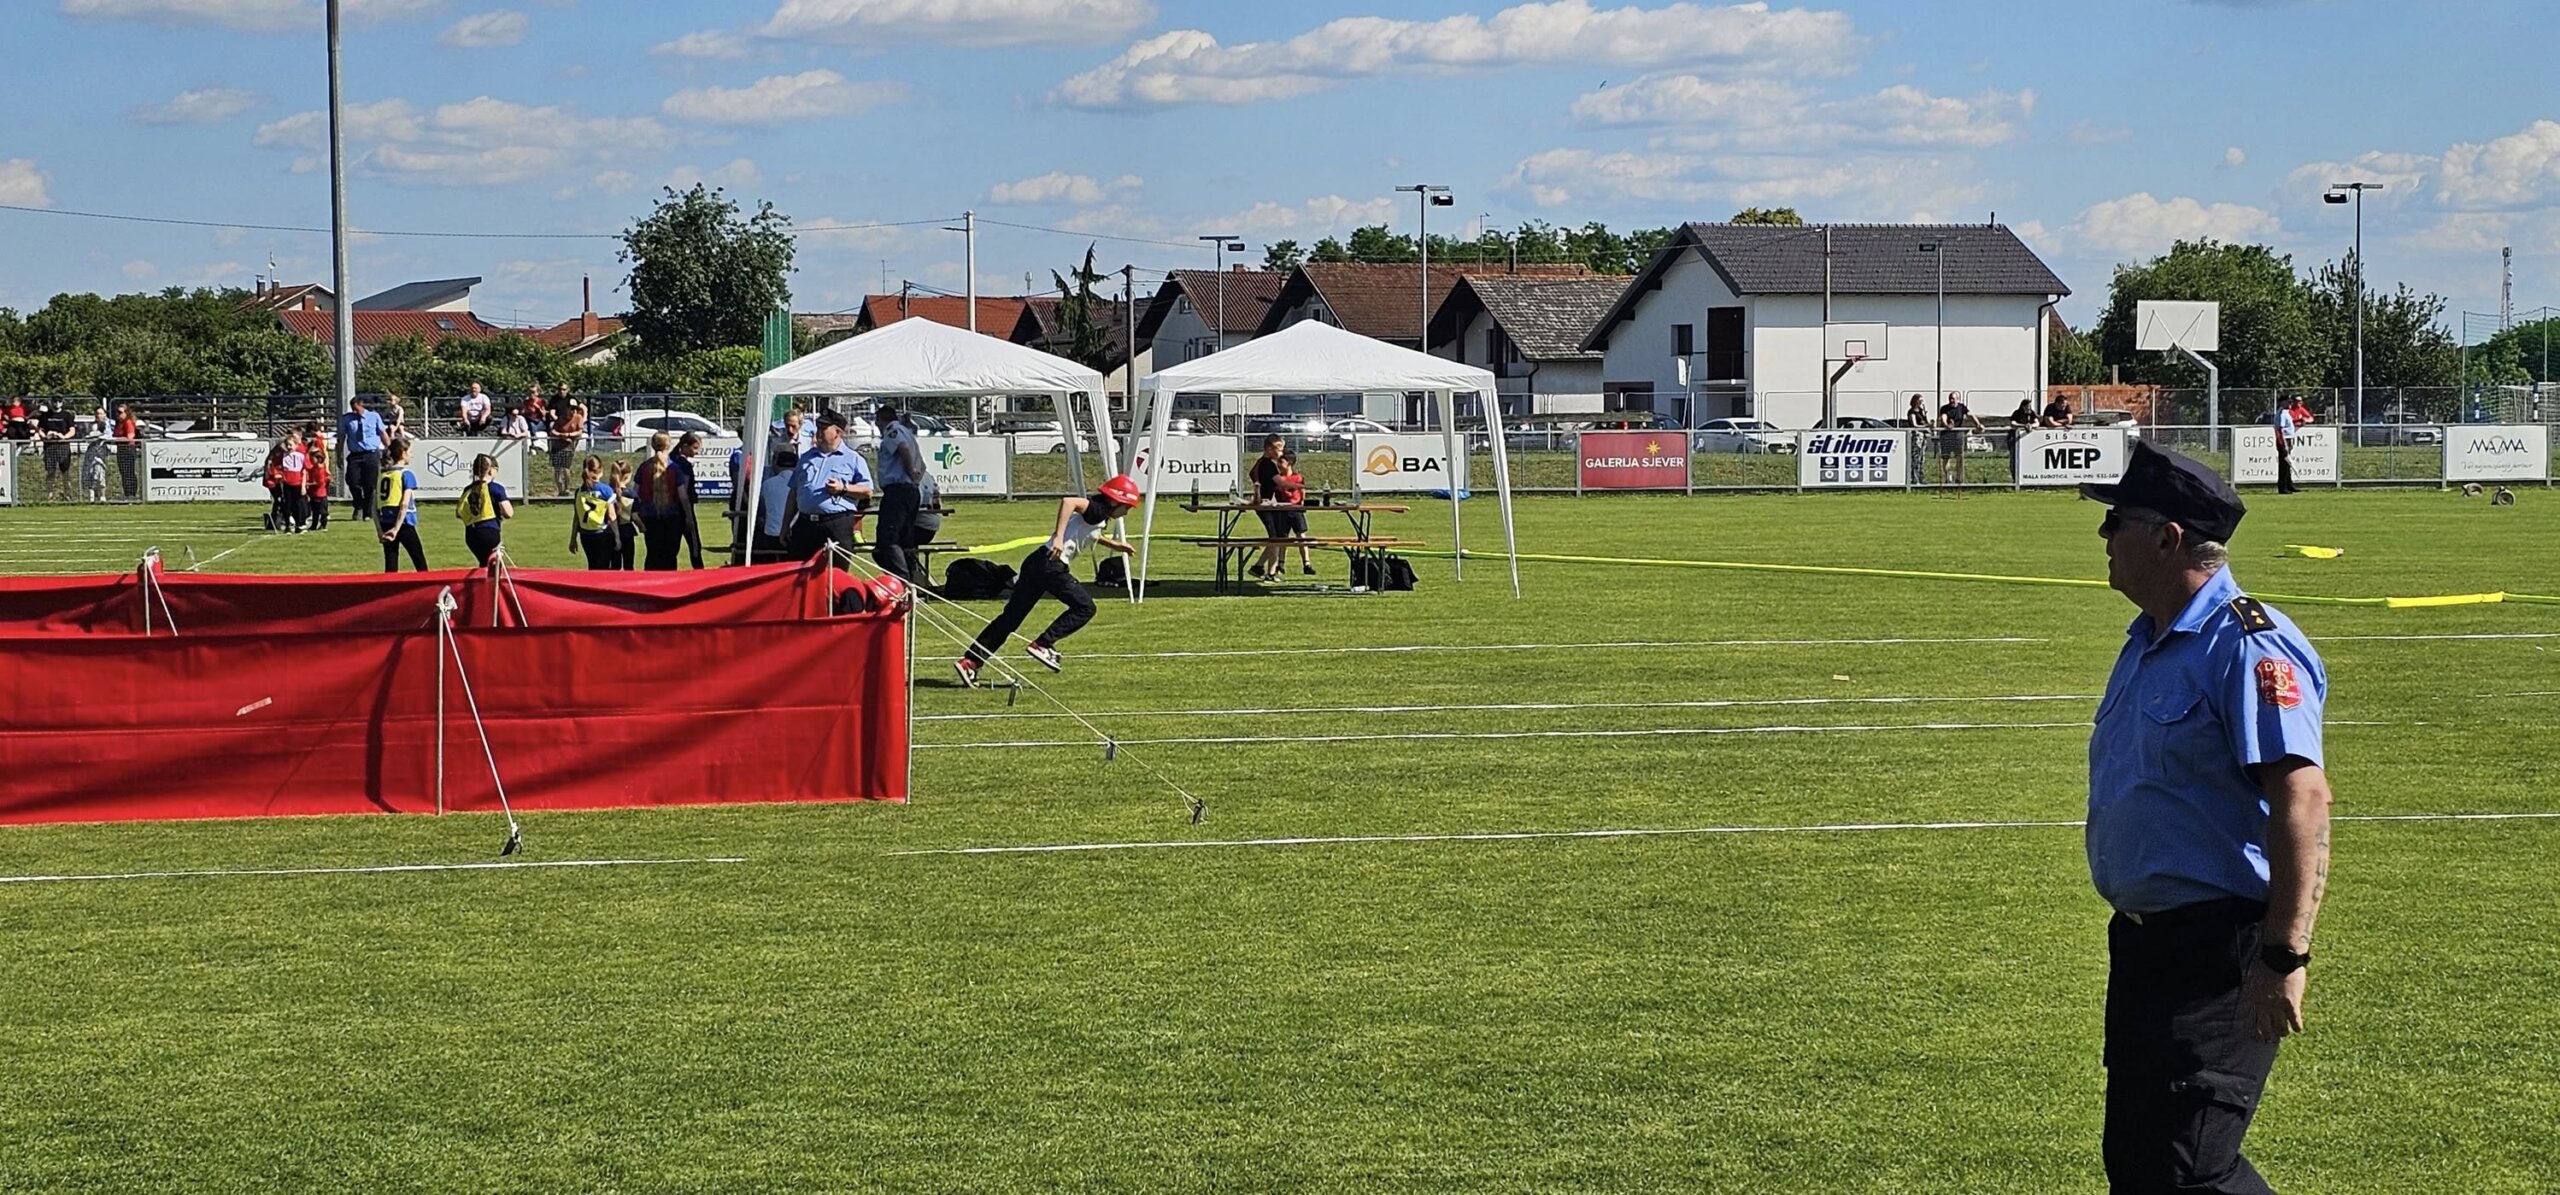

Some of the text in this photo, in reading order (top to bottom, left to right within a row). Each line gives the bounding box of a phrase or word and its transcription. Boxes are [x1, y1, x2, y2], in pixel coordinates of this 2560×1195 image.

[2243, 436, 2314, 448] GIPSNT
[1585, 457, 1684, 468] GALERIJA SJEVER
[2045, 448, 2101, 469] MEP
[1168, 459, 1232, 473] Đurkin
[962, 474, 988, 483] PETE
